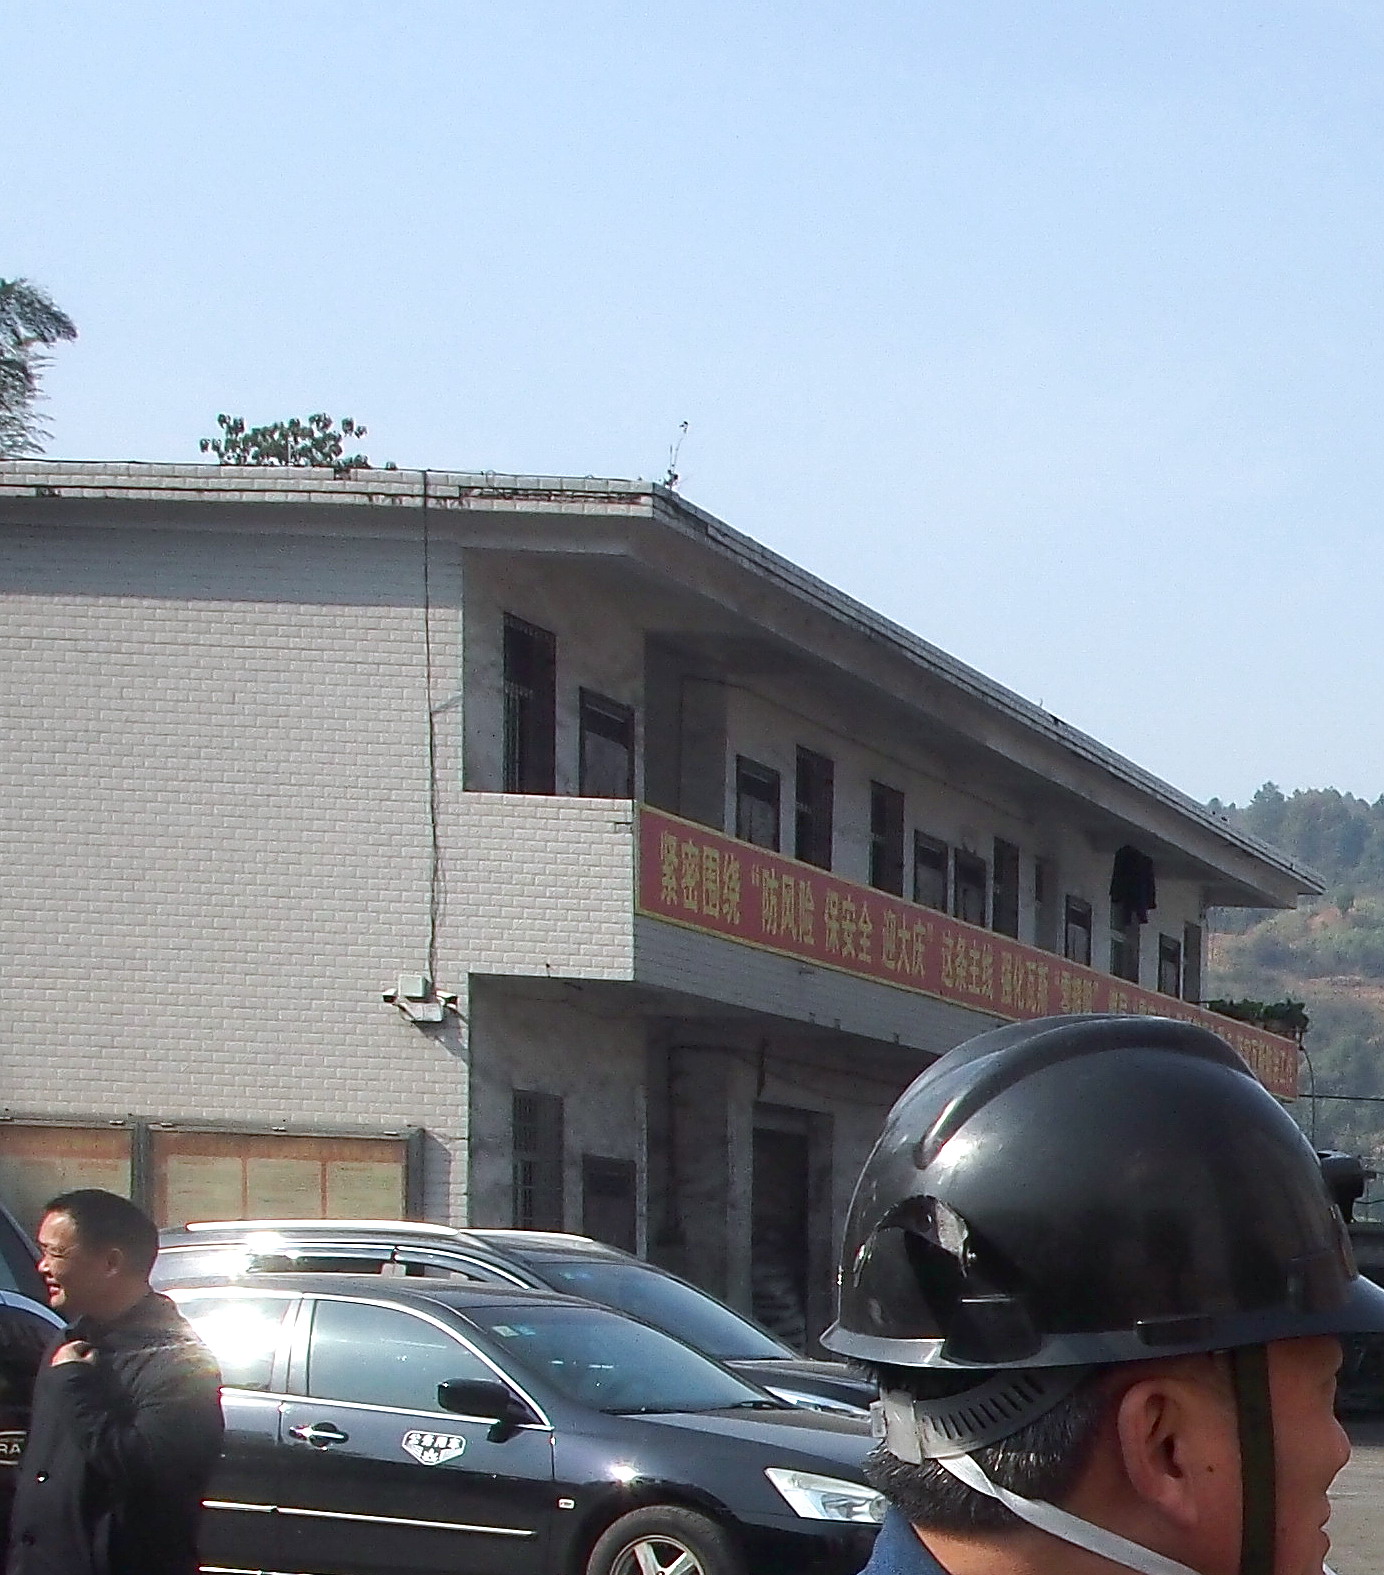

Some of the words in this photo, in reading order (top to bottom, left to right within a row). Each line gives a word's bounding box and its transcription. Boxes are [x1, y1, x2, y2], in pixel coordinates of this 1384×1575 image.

[659, 830, 742, 925] 紧密围绕
[824, 888, 873, 963] 保安全
